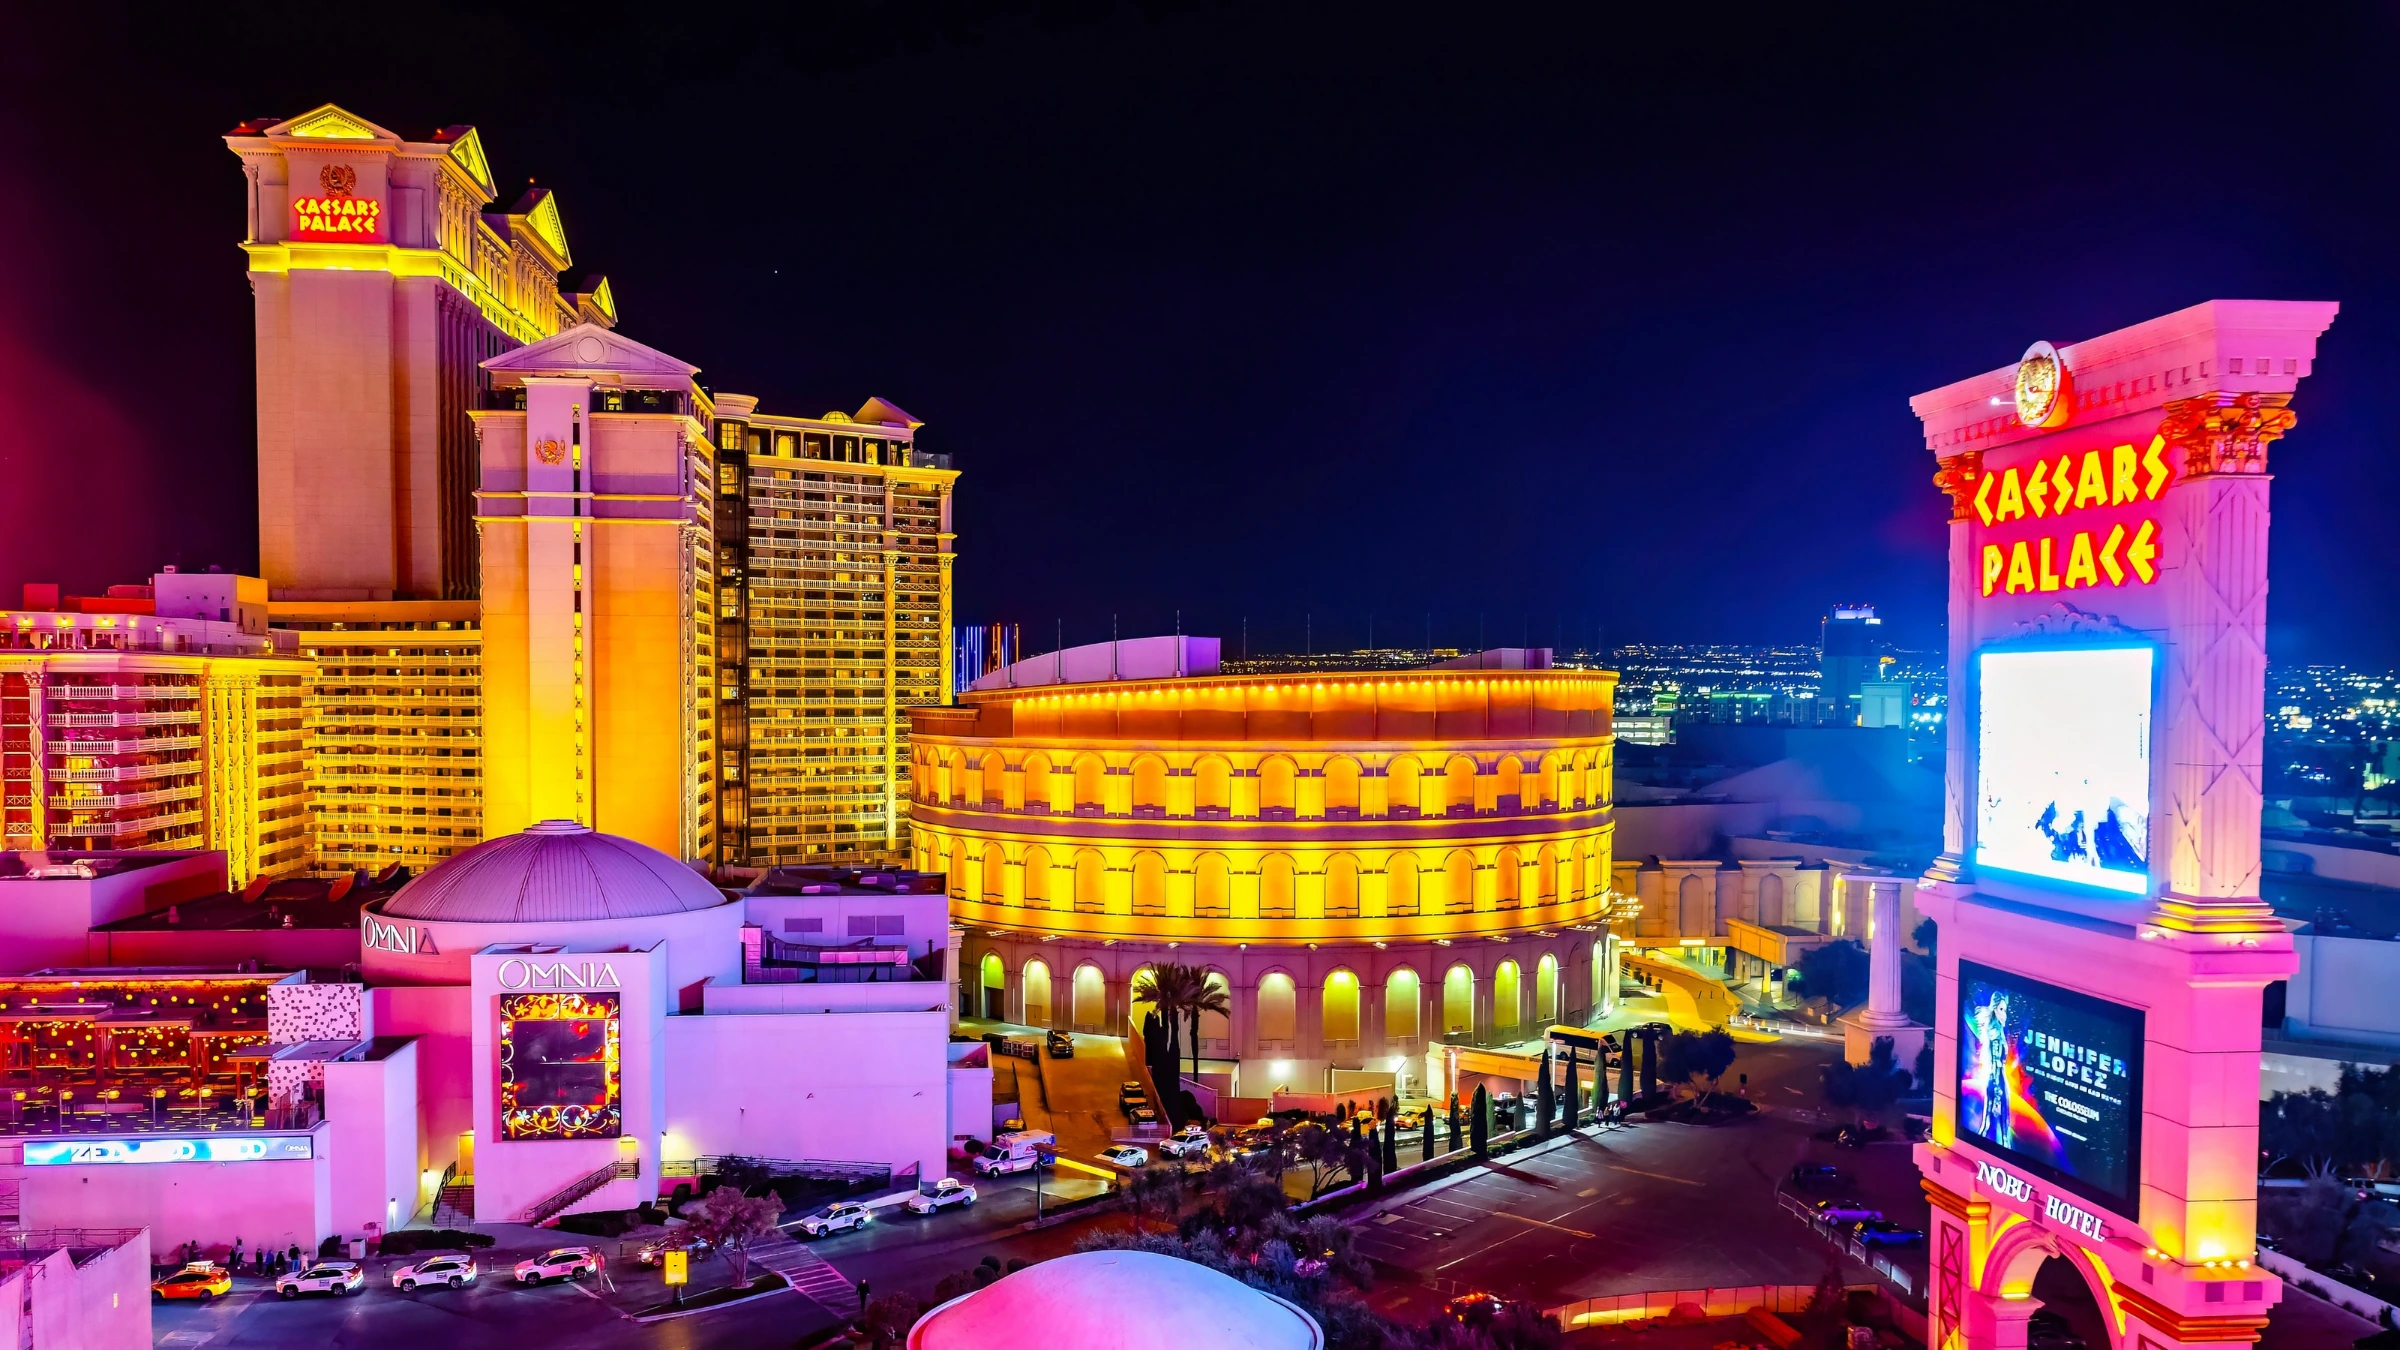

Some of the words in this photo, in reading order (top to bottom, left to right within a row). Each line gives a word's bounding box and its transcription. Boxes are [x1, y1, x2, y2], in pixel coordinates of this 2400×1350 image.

[294, 198, 380, 216] CAESARS
[300, 215, 375, 233] PALACE
[1973, 434, 2171, 527] CAESARS
[1982, 520, 2156, 597] PALACE
[363, 916, 440, 955] OMNIA
[498, 959, 622, 990] OMNIA
[2024, 1029, 2127, 1078] JENNIFER
[2040, 1051, 2107, 1090] LOPEZ
[2044, 1090, 2058, 1105] THE
[1976, 1160, 2033, 1203] NOBU
[2045, 1194, 2106, 1242] HOTEL
